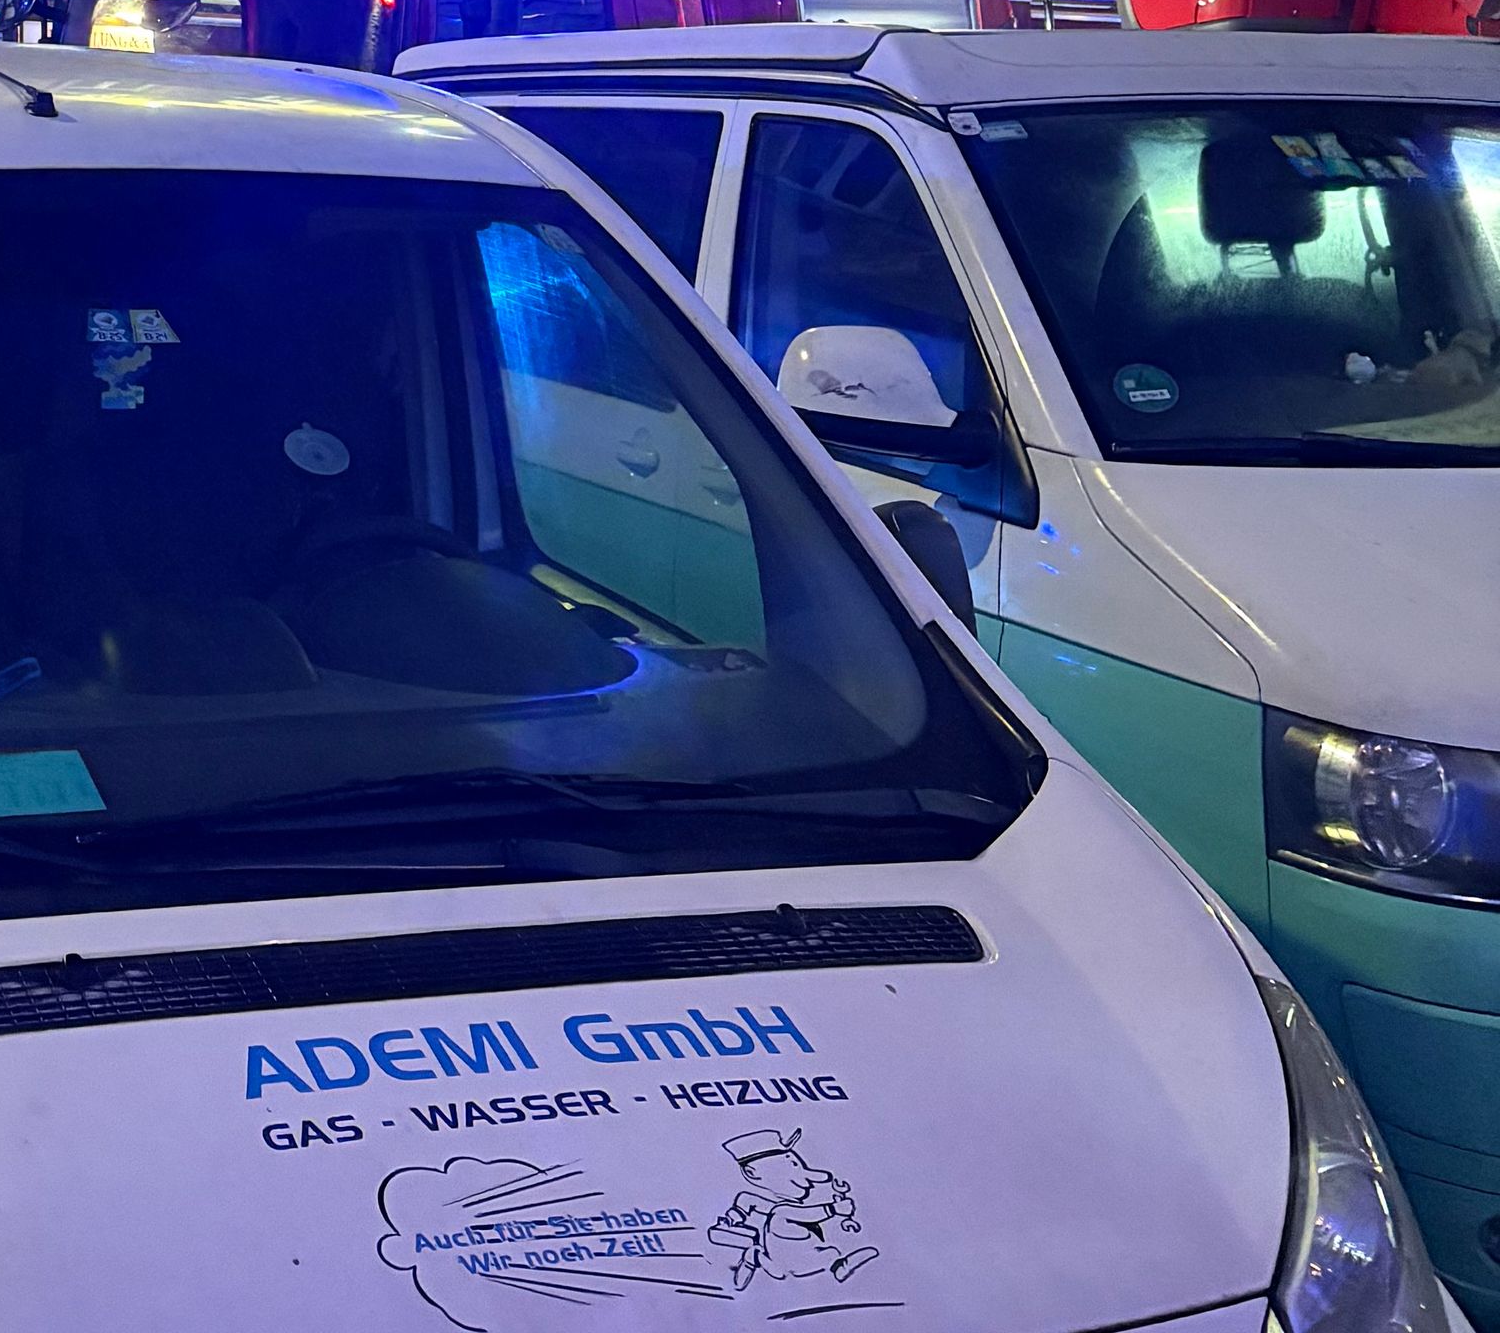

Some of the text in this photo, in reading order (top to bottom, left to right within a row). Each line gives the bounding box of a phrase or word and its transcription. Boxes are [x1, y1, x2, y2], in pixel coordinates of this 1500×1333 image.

[245, 1005, 816, 1100] ADEMI GmbH
[262, 1114, 364, 1151] GAS
[410, 1089, 621, 1132] WASSER
[660, 1076, 849, 1110] HEIZUNG
[414, 1225, 487, 1254] Auch
[547, 1214, 593, 1238] Sie
[600, 1207, 688, 1231] haben
[457, 1232, 667, 1275] Wir noch Zeit!
